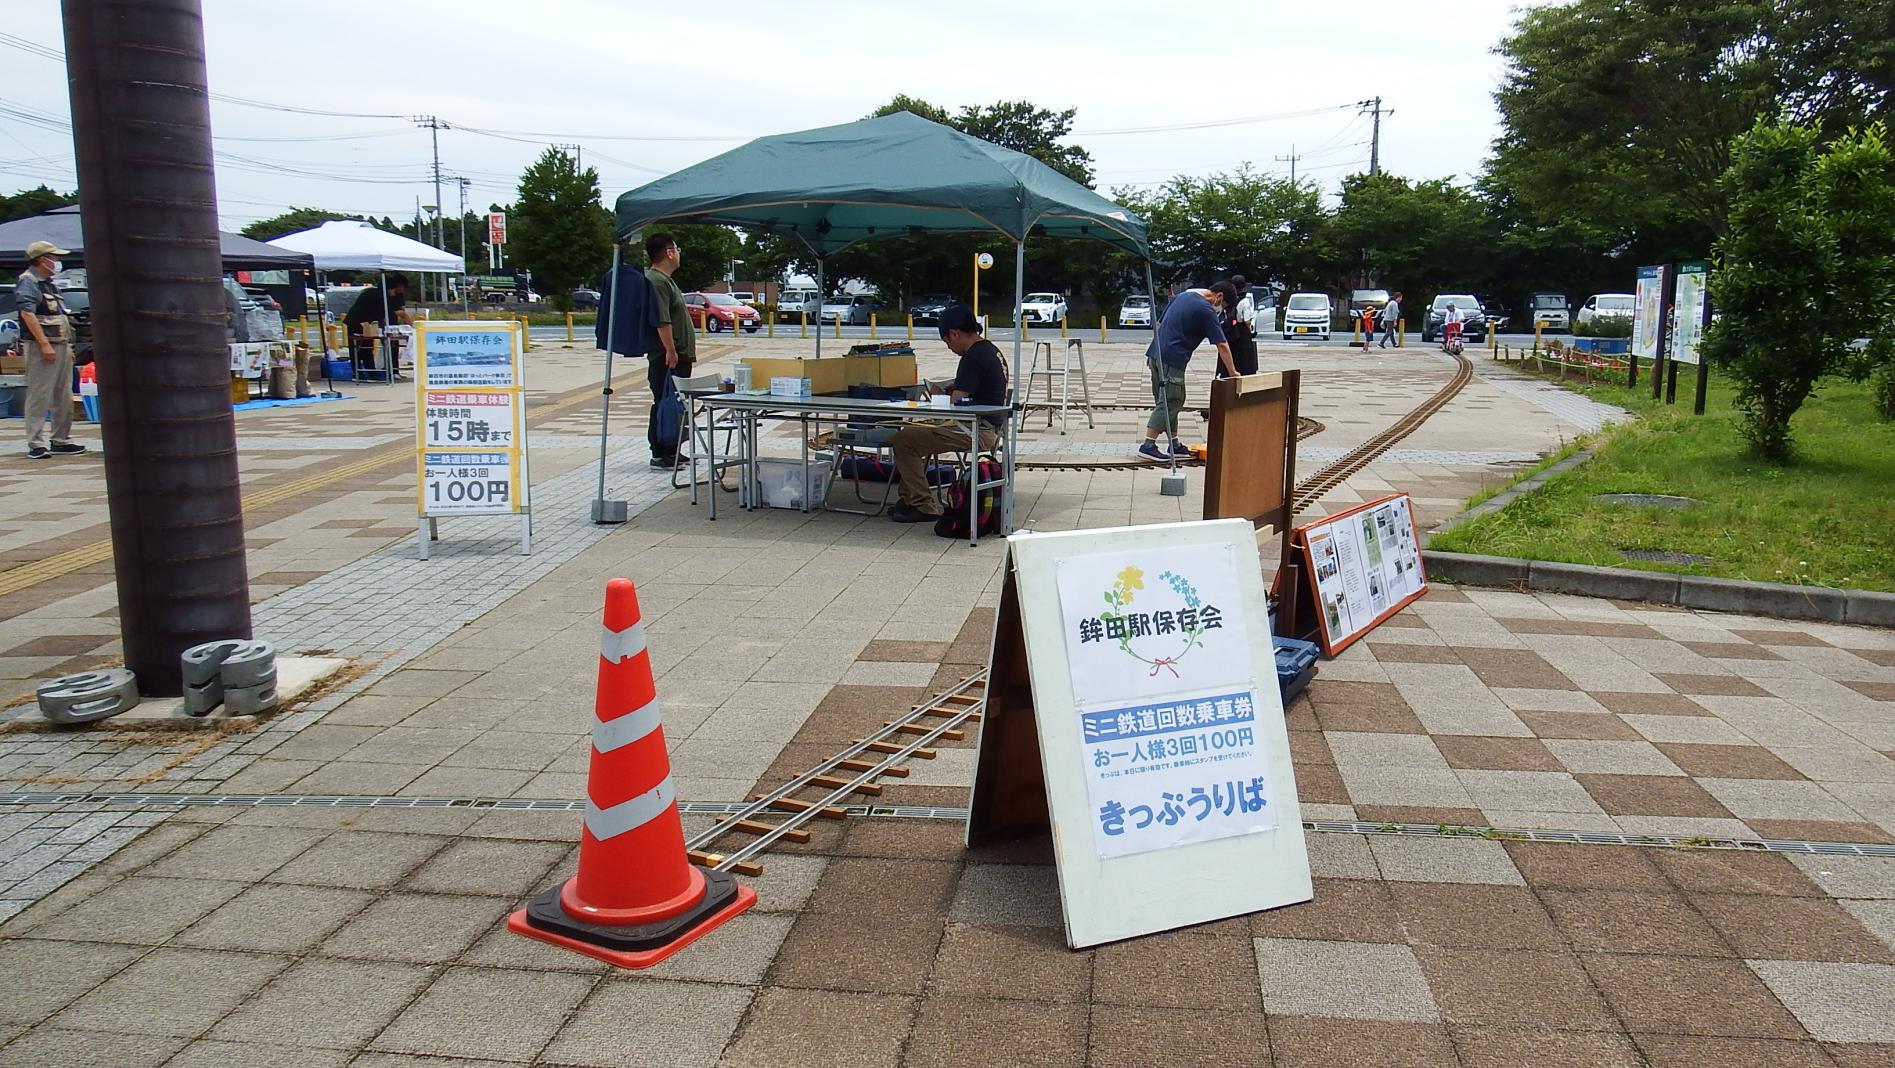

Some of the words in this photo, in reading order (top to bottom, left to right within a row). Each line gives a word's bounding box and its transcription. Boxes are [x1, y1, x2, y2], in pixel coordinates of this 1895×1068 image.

[435, 335, 503, 346] 鉾田駅保存会
[426, 408, 471, 419] 体験時間
[428, 420, 512, 442] 15時まで
[425, 467, 489, 478] お一人様3回
[429, 480, 509, 502] 100円
[1079, 604, 1223, 644] 鉾田駅保存会
[1084, 696, 1253, 737] ミニ鉄道回数乗車券
[1094, 727, 1254, 767] お一人様3回100円
[1100, 776, 1267, 836] きっぷうりば
